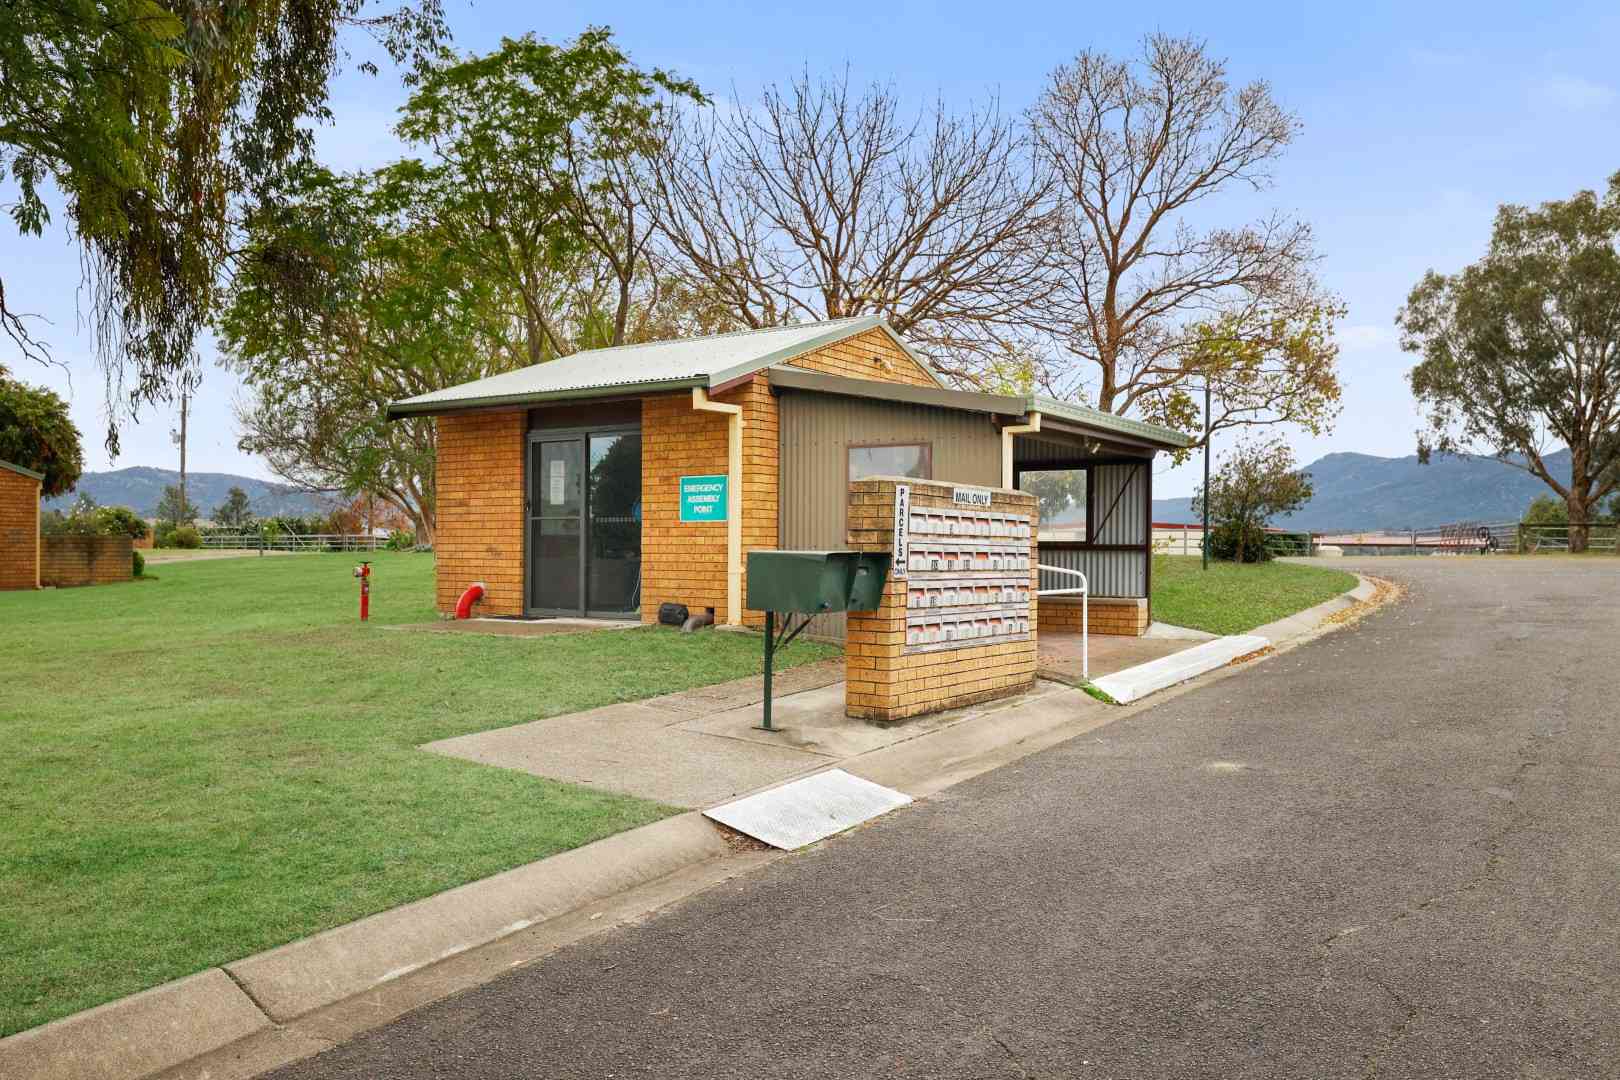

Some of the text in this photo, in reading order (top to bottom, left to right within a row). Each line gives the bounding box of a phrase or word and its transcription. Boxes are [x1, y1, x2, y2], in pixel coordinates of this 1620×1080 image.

[684, 484, 723, 493] EMERGENCY
[955, 491, 989, 505] MAIL ONLY
[694, 505, 712, 513] POINT
[897, 488, 905, 557] PARCELS
